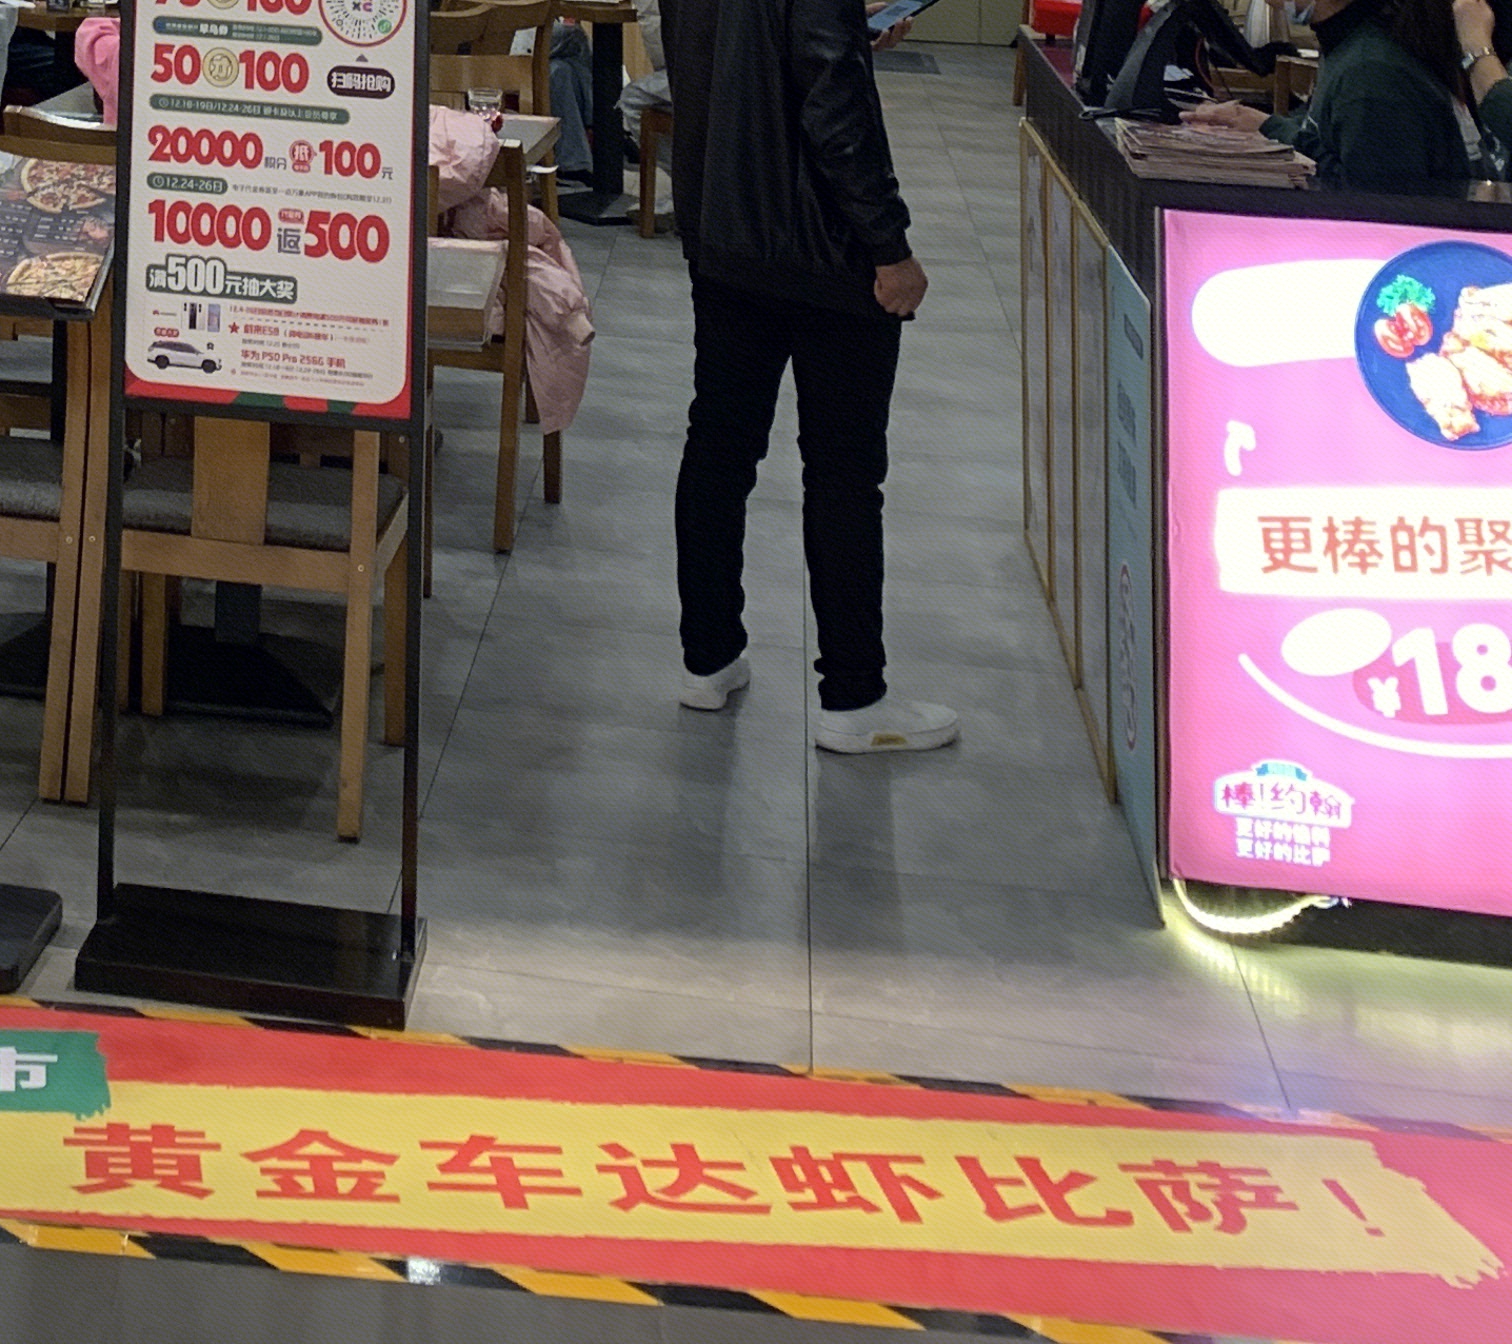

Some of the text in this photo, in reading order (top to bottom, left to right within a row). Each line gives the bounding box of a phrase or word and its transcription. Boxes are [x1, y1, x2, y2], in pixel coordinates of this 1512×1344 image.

[150, 43, 310, 94] 50 100
[147, 124, 263, 170] 20000
[318, 139, 382, 179] 100
[147, 198, 272, 251] 10000
[303, 209, 391, 264] 500
[62, 1120, 1384, 1238] 黄金车达虾比萨!
